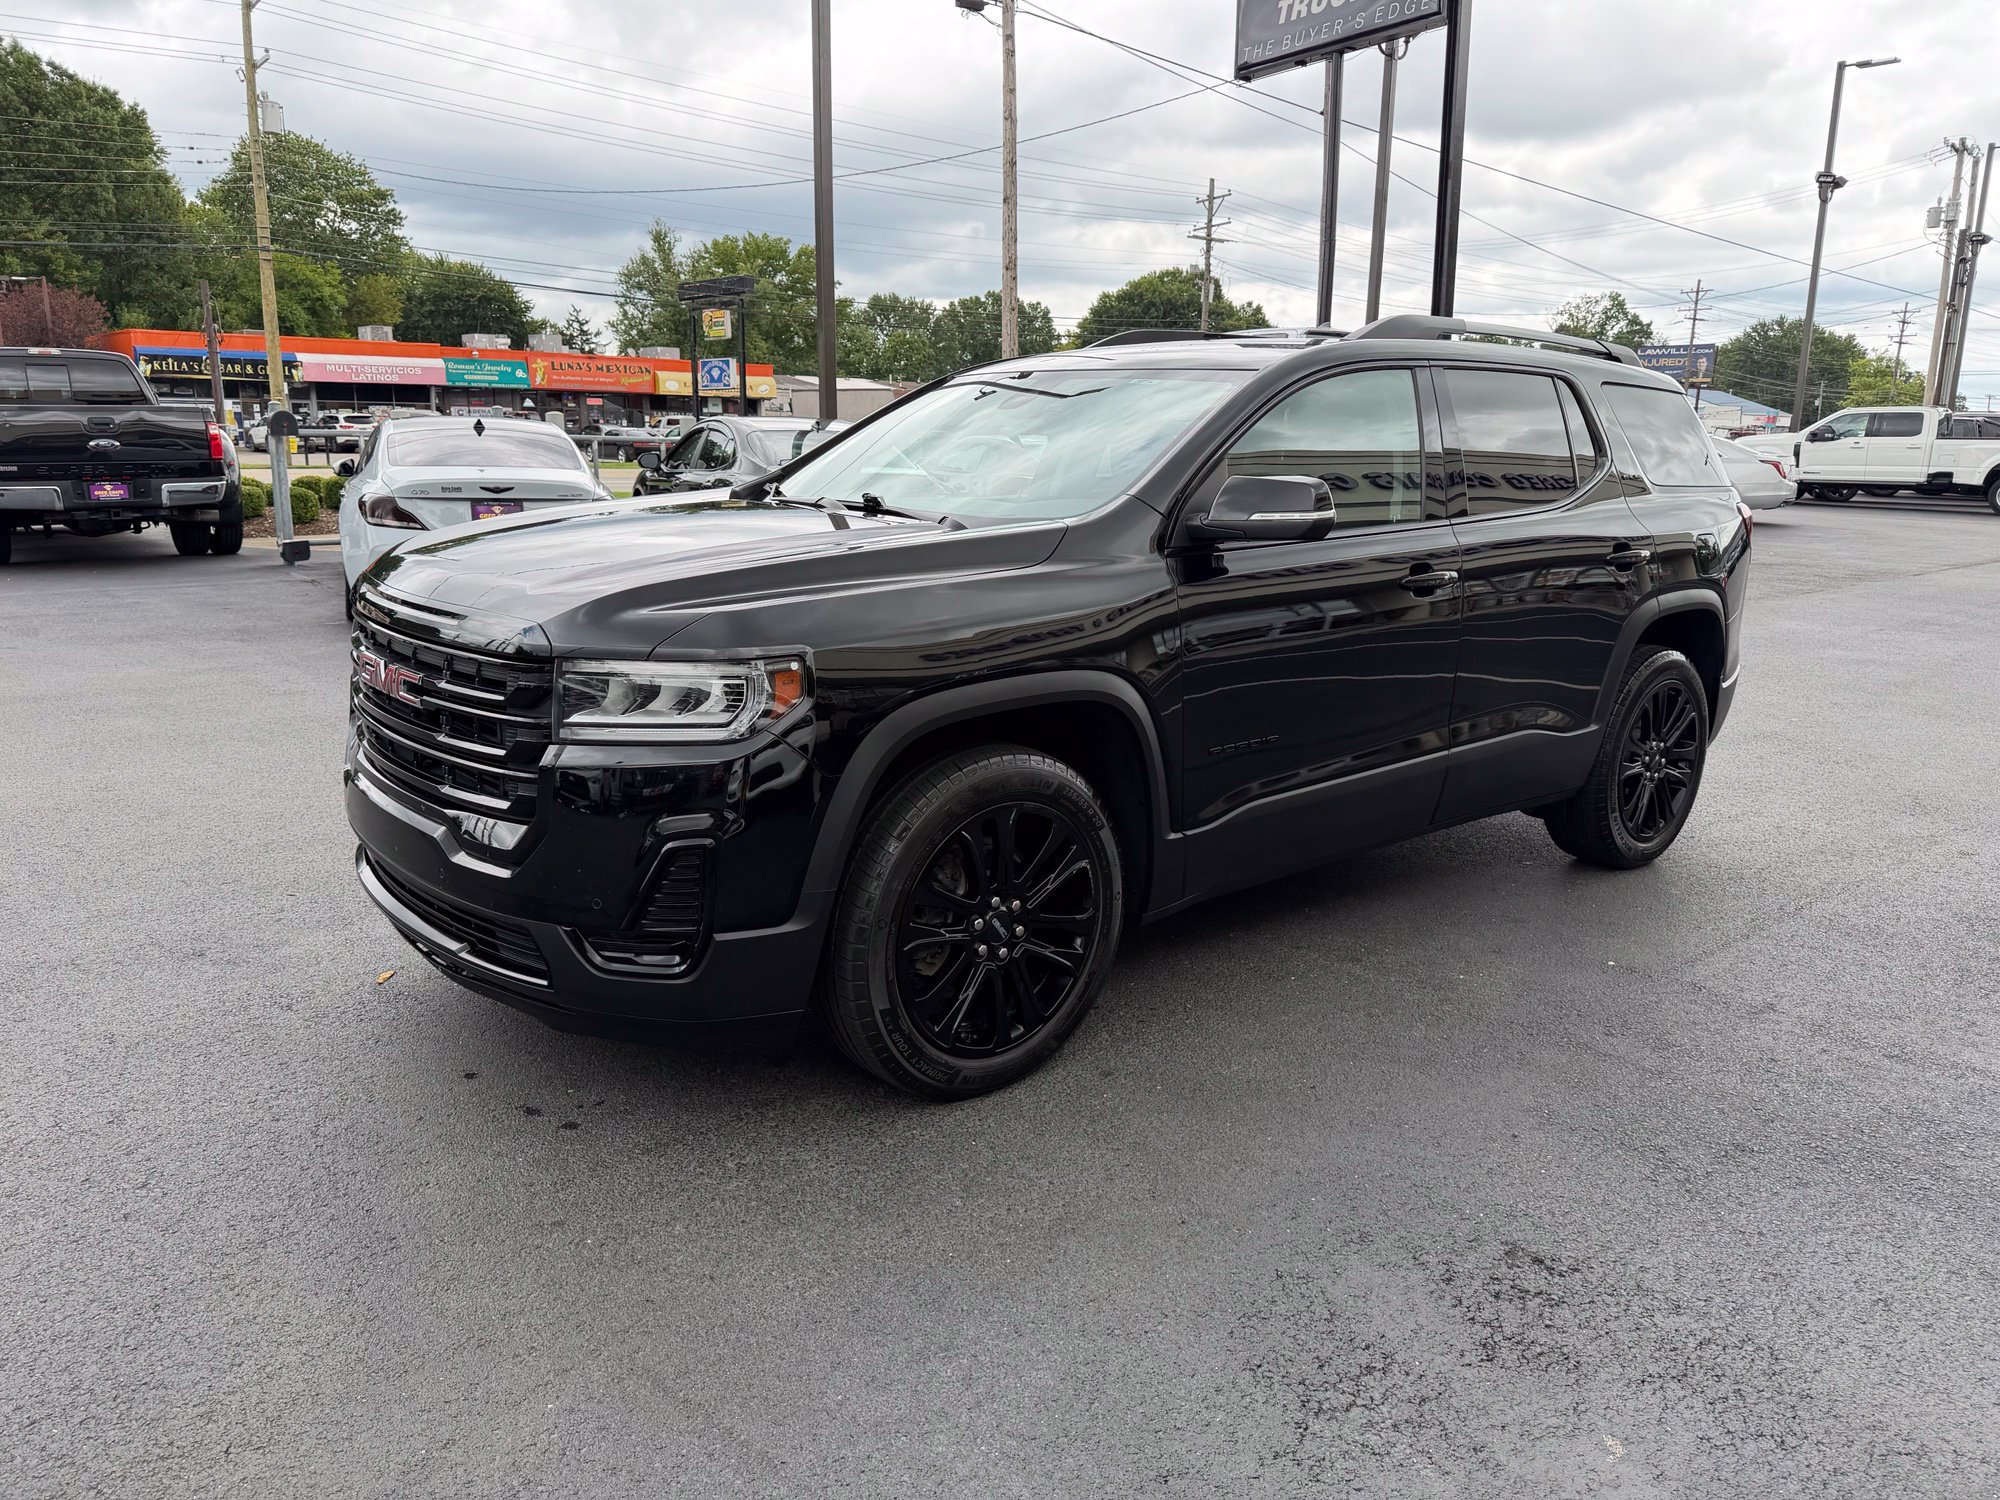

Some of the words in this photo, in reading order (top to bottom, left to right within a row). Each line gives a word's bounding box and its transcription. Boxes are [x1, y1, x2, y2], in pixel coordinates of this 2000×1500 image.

[1277, 0, 1355, 25] TRU
[1243, 39, 1275, 61] THE
[1281, 13, 1366, 51] BUYER'S
[1374, 0, 1431, 23] EDGE
[245, 363, 254, 374] &
[446, 362, 480, 370] Roman's
[482, 363, 512, 372] Jewelry
[551, 361, 592, 372] LUNA'S
[595, 364, 652, 375] MEXICAN
[1640, 357, 1689, 367] NJURED?
[351, 373, 399, 382] LATINOS
[358, 645, 423, 708] GMC
[891, 1031, 912, 1057] TOUR
[910, 1056, 950, 1083] PRIMACY
